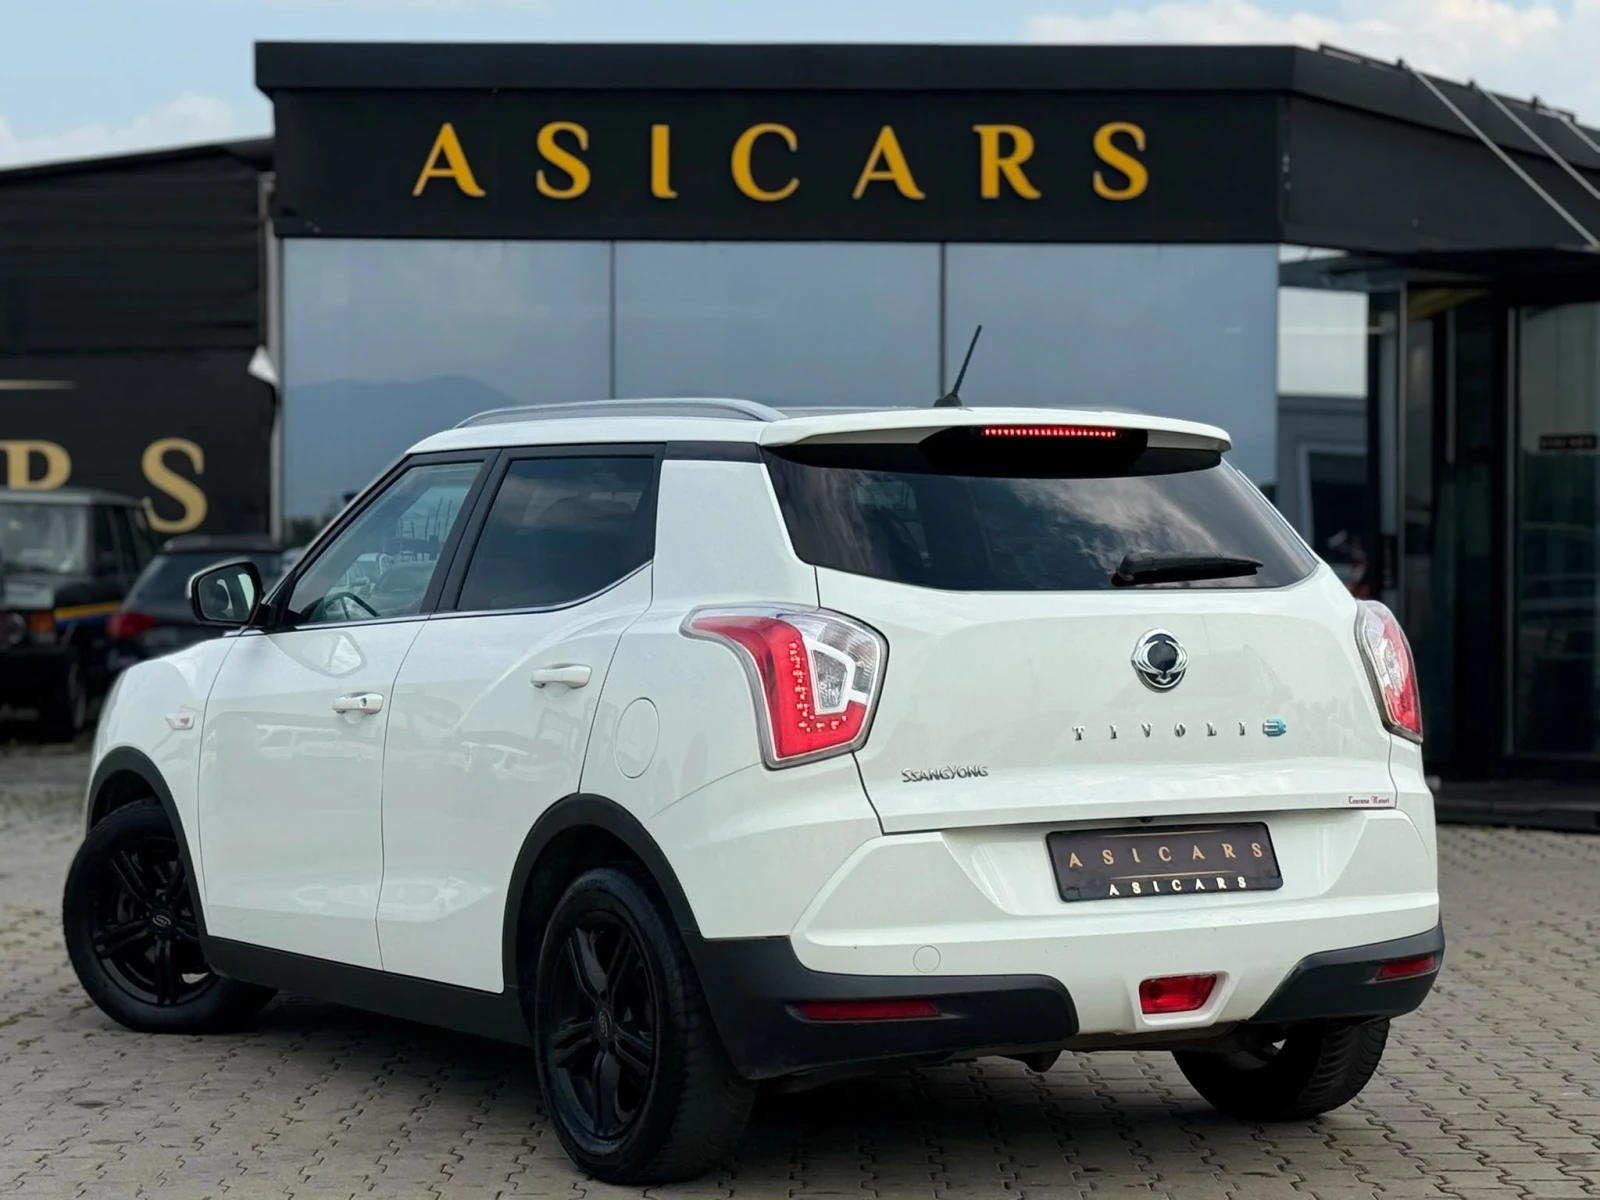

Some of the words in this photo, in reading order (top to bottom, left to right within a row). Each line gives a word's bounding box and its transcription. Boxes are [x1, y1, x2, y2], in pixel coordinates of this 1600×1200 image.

[412, 121, 1149, 202] ASICARS
[1072, 721, 1247, 741] TIVOLI
[1068, 842, 1263, 868] ASICARS
[1108, 875, 1247, 896] ASICARS
